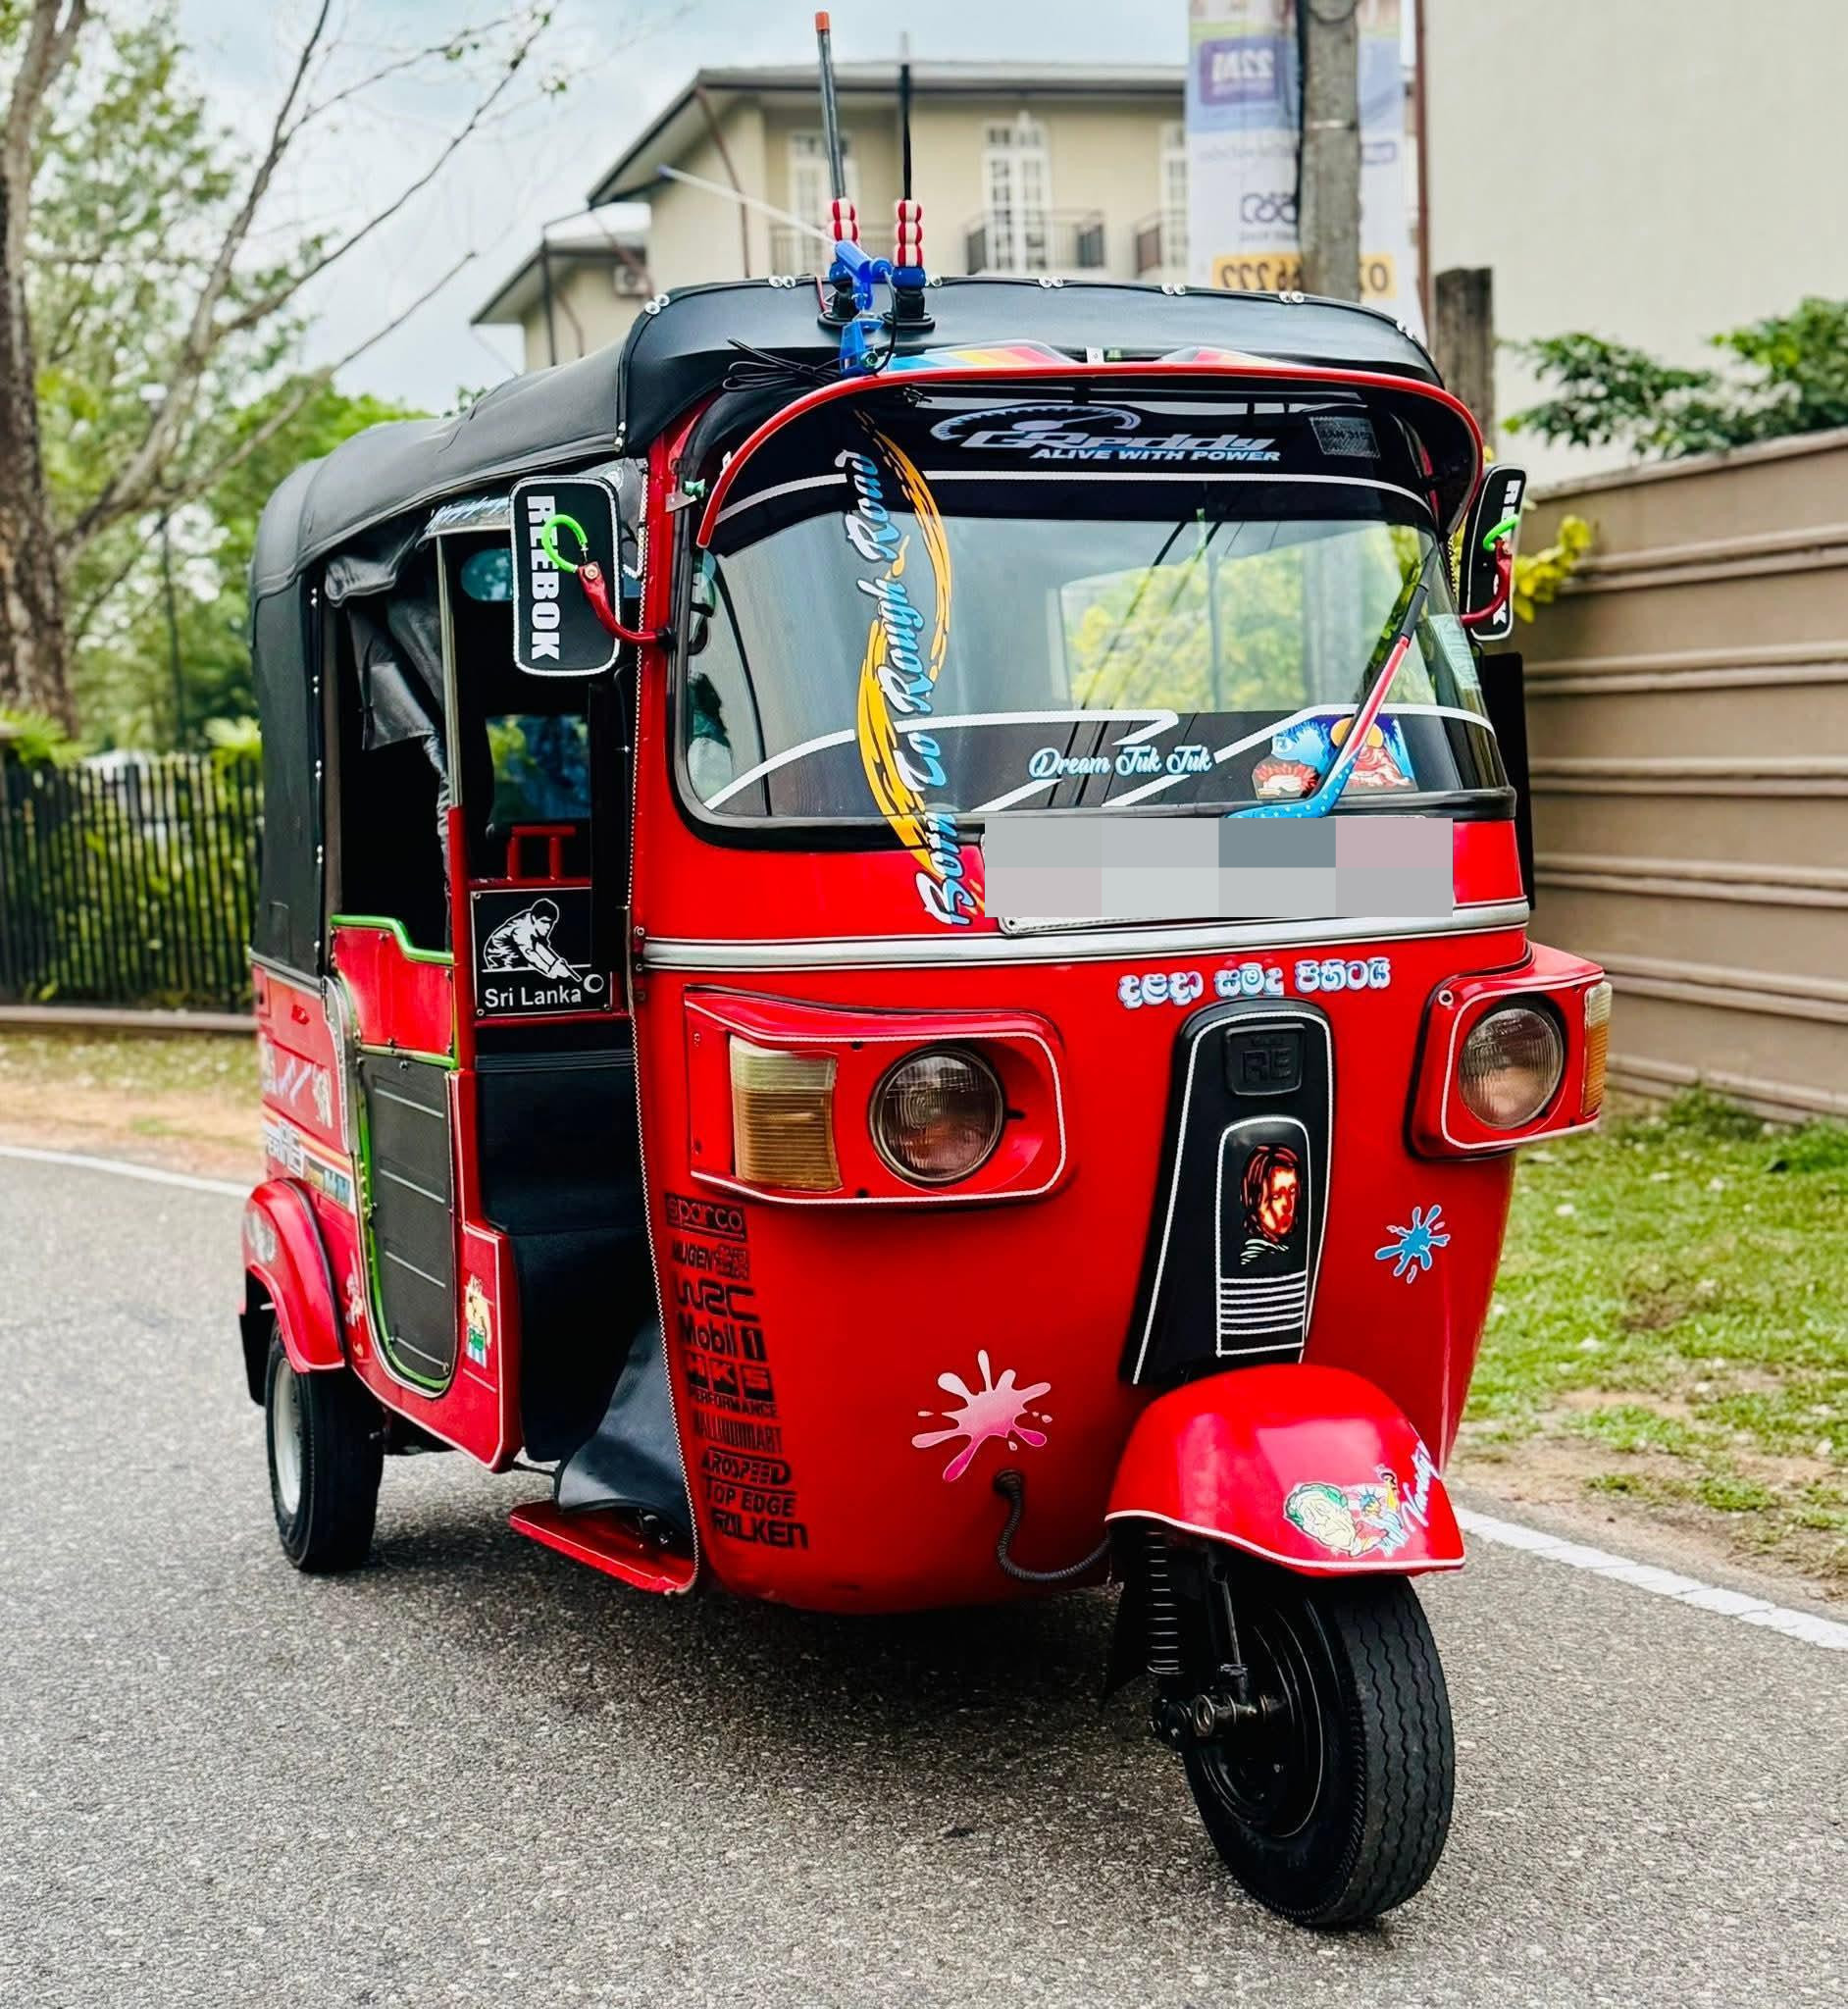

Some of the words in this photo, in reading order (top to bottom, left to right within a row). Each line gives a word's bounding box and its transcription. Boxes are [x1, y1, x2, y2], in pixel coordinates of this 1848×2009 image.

[1030, 448, 1111, 460] ALIVE
[1118, 449, 1182, 461] WITH
[1190, 450, 1281, 462] POWER
[835, 448, 902, 564] Road
[857, 576, 935, 716] Rough
[894, 731, 950, 793] To
[1028, 747, 1111, 778] Dream
[1115, 745, 1162, 776] Tuk
[1166, 744, 1212, 775] Tuk
[914, 811, 973, 927] Born
[485, 987, 514, 1007] Sri
[521, 984, 582, 1005] Lanka
[678, 1311, 738, 1358] Mobil
[741, 1490, 796, 1518] EDGE
